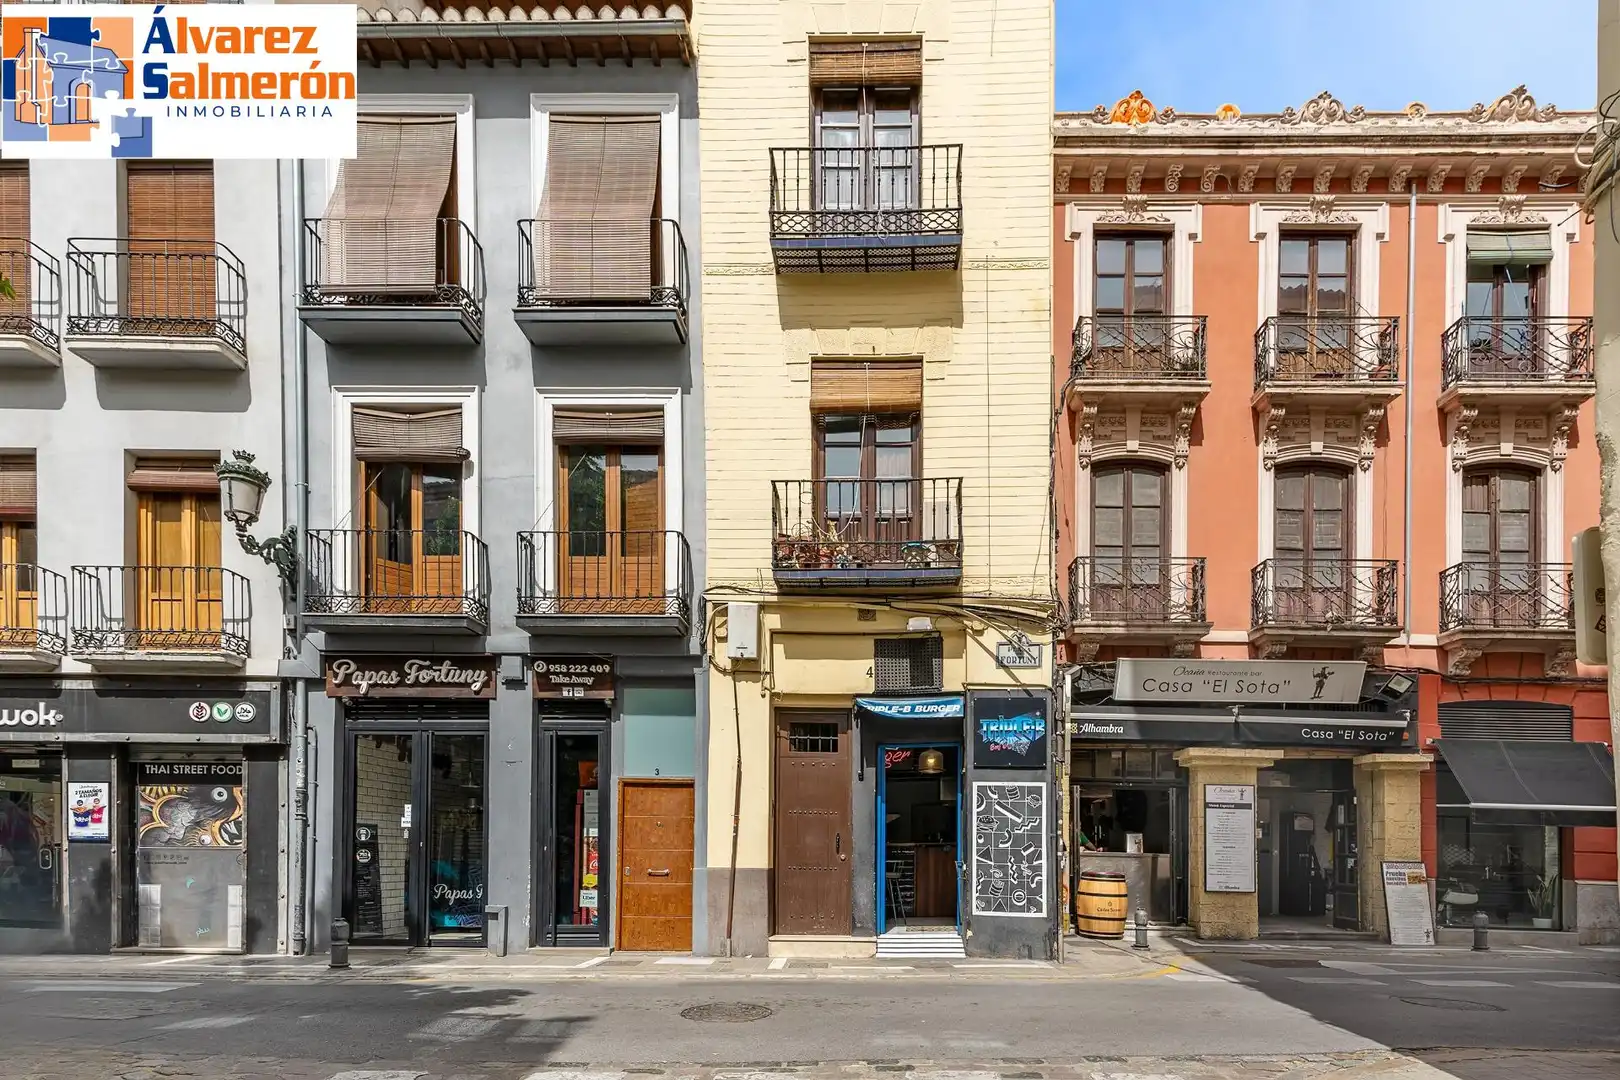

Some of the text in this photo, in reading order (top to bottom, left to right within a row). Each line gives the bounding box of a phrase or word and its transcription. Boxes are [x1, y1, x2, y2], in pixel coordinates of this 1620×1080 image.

[548, 664, 611, 673] 958 222 409
[866, 666, 873, 678] 4
[332, 659, 488, 694] Papas Fortuny
[549, 675, 595, 685] Take Away
[1142, 678, 1193, 693] Casa
[866, 704, 960, 713] RIPLE-B BURGER
[1080, 723, 1124, 733] Alhambra
[1301, 728, 1333, 739] Casa
[145, 764, 243, 774] THAI STREET FOOD
[655, 768, 659, 776] 3
[434, 884, 473, 905] Papas
